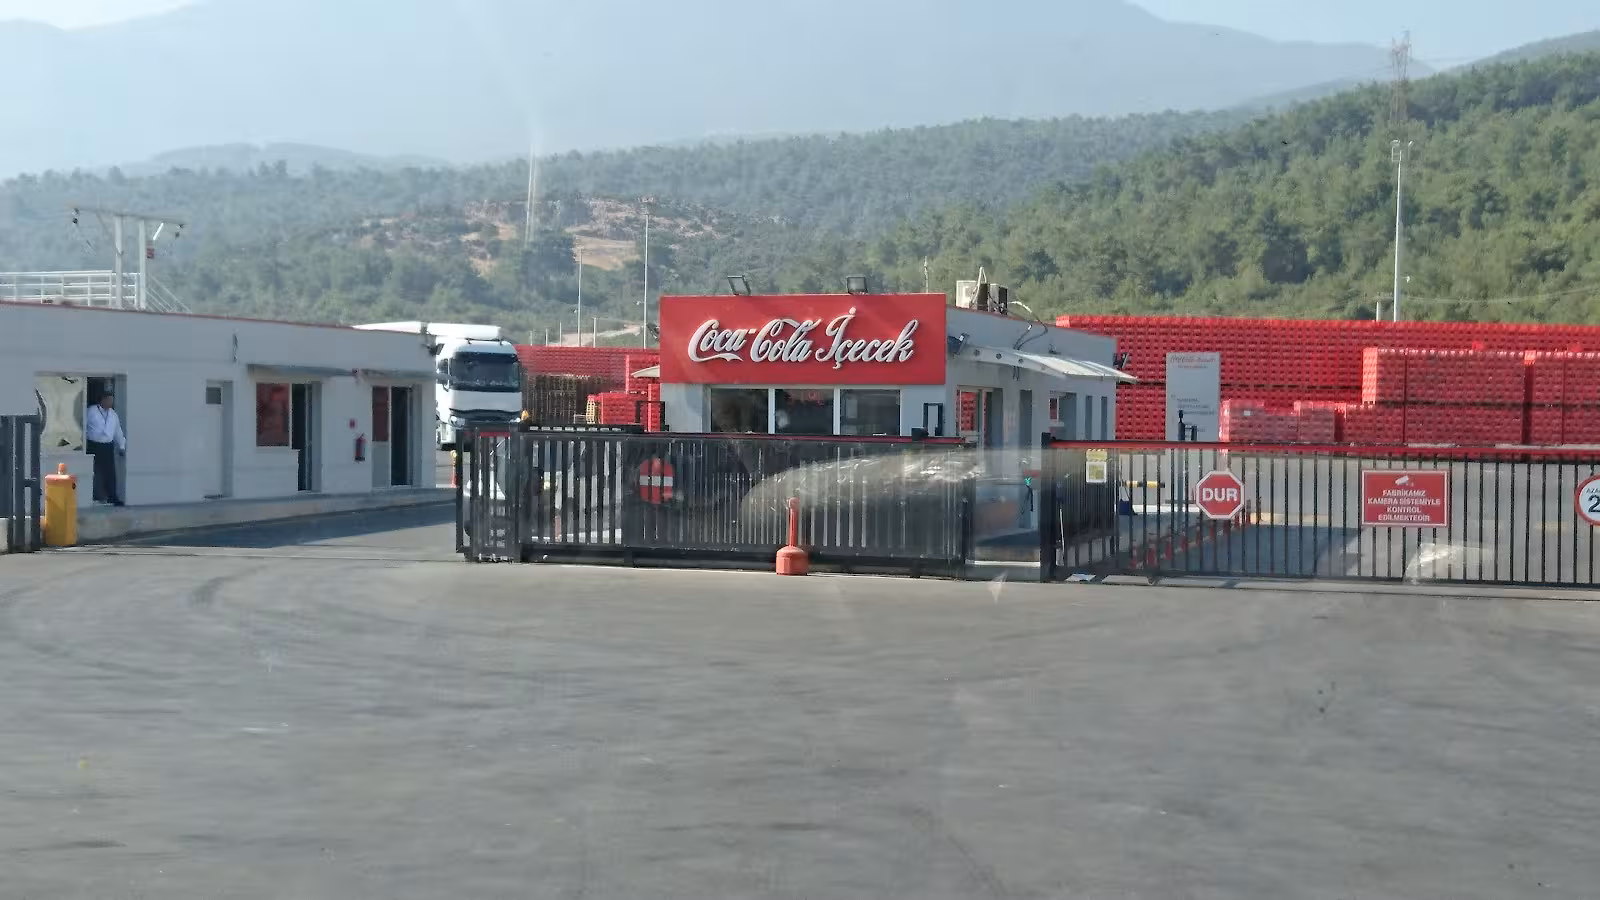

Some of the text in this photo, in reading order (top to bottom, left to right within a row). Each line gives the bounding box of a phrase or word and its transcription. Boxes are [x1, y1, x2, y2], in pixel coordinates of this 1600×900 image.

[688, 306, 919, 370] Coca-Cola İçecek
[1202, 487, 1238, 502] DUR
